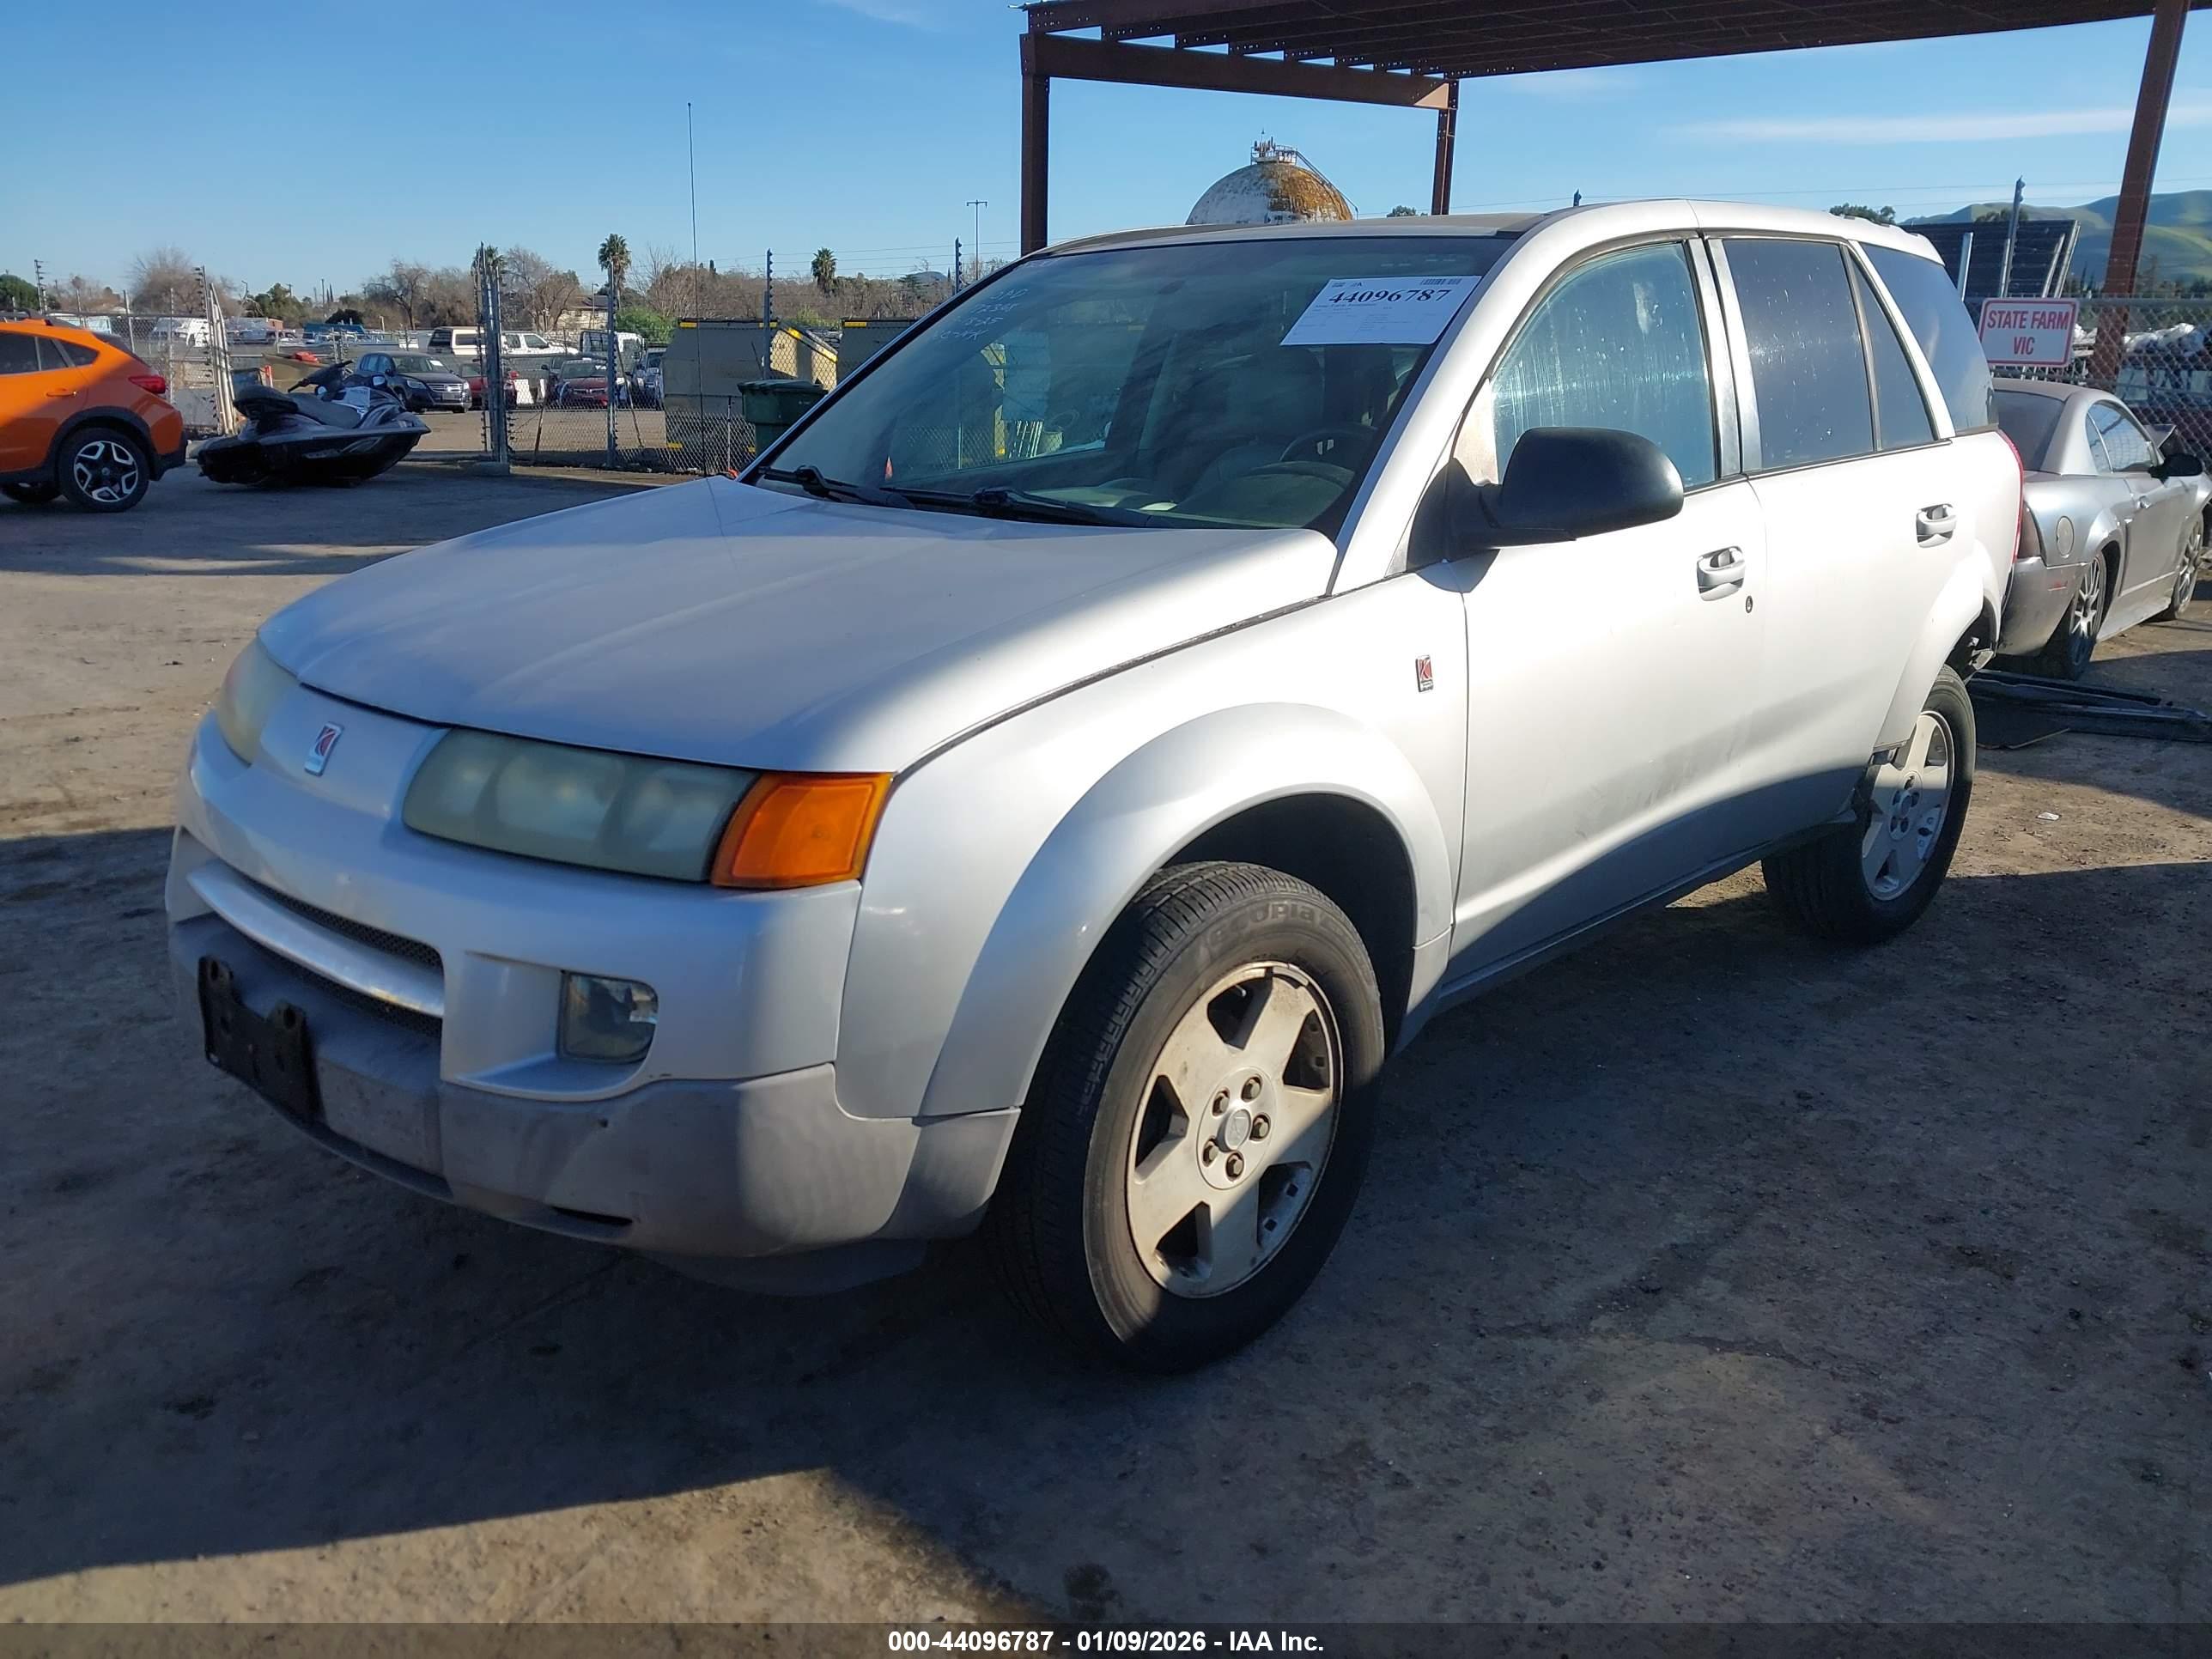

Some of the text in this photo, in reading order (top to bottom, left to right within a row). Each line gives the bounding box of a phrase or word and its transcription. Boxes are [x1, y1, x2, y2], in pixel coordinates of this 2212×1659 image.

[1328, 289, 1452, 304] 44096787
[1987, 310, 2070, 330] STATE FARM
[2013, 336, 2035, 356] VIC
